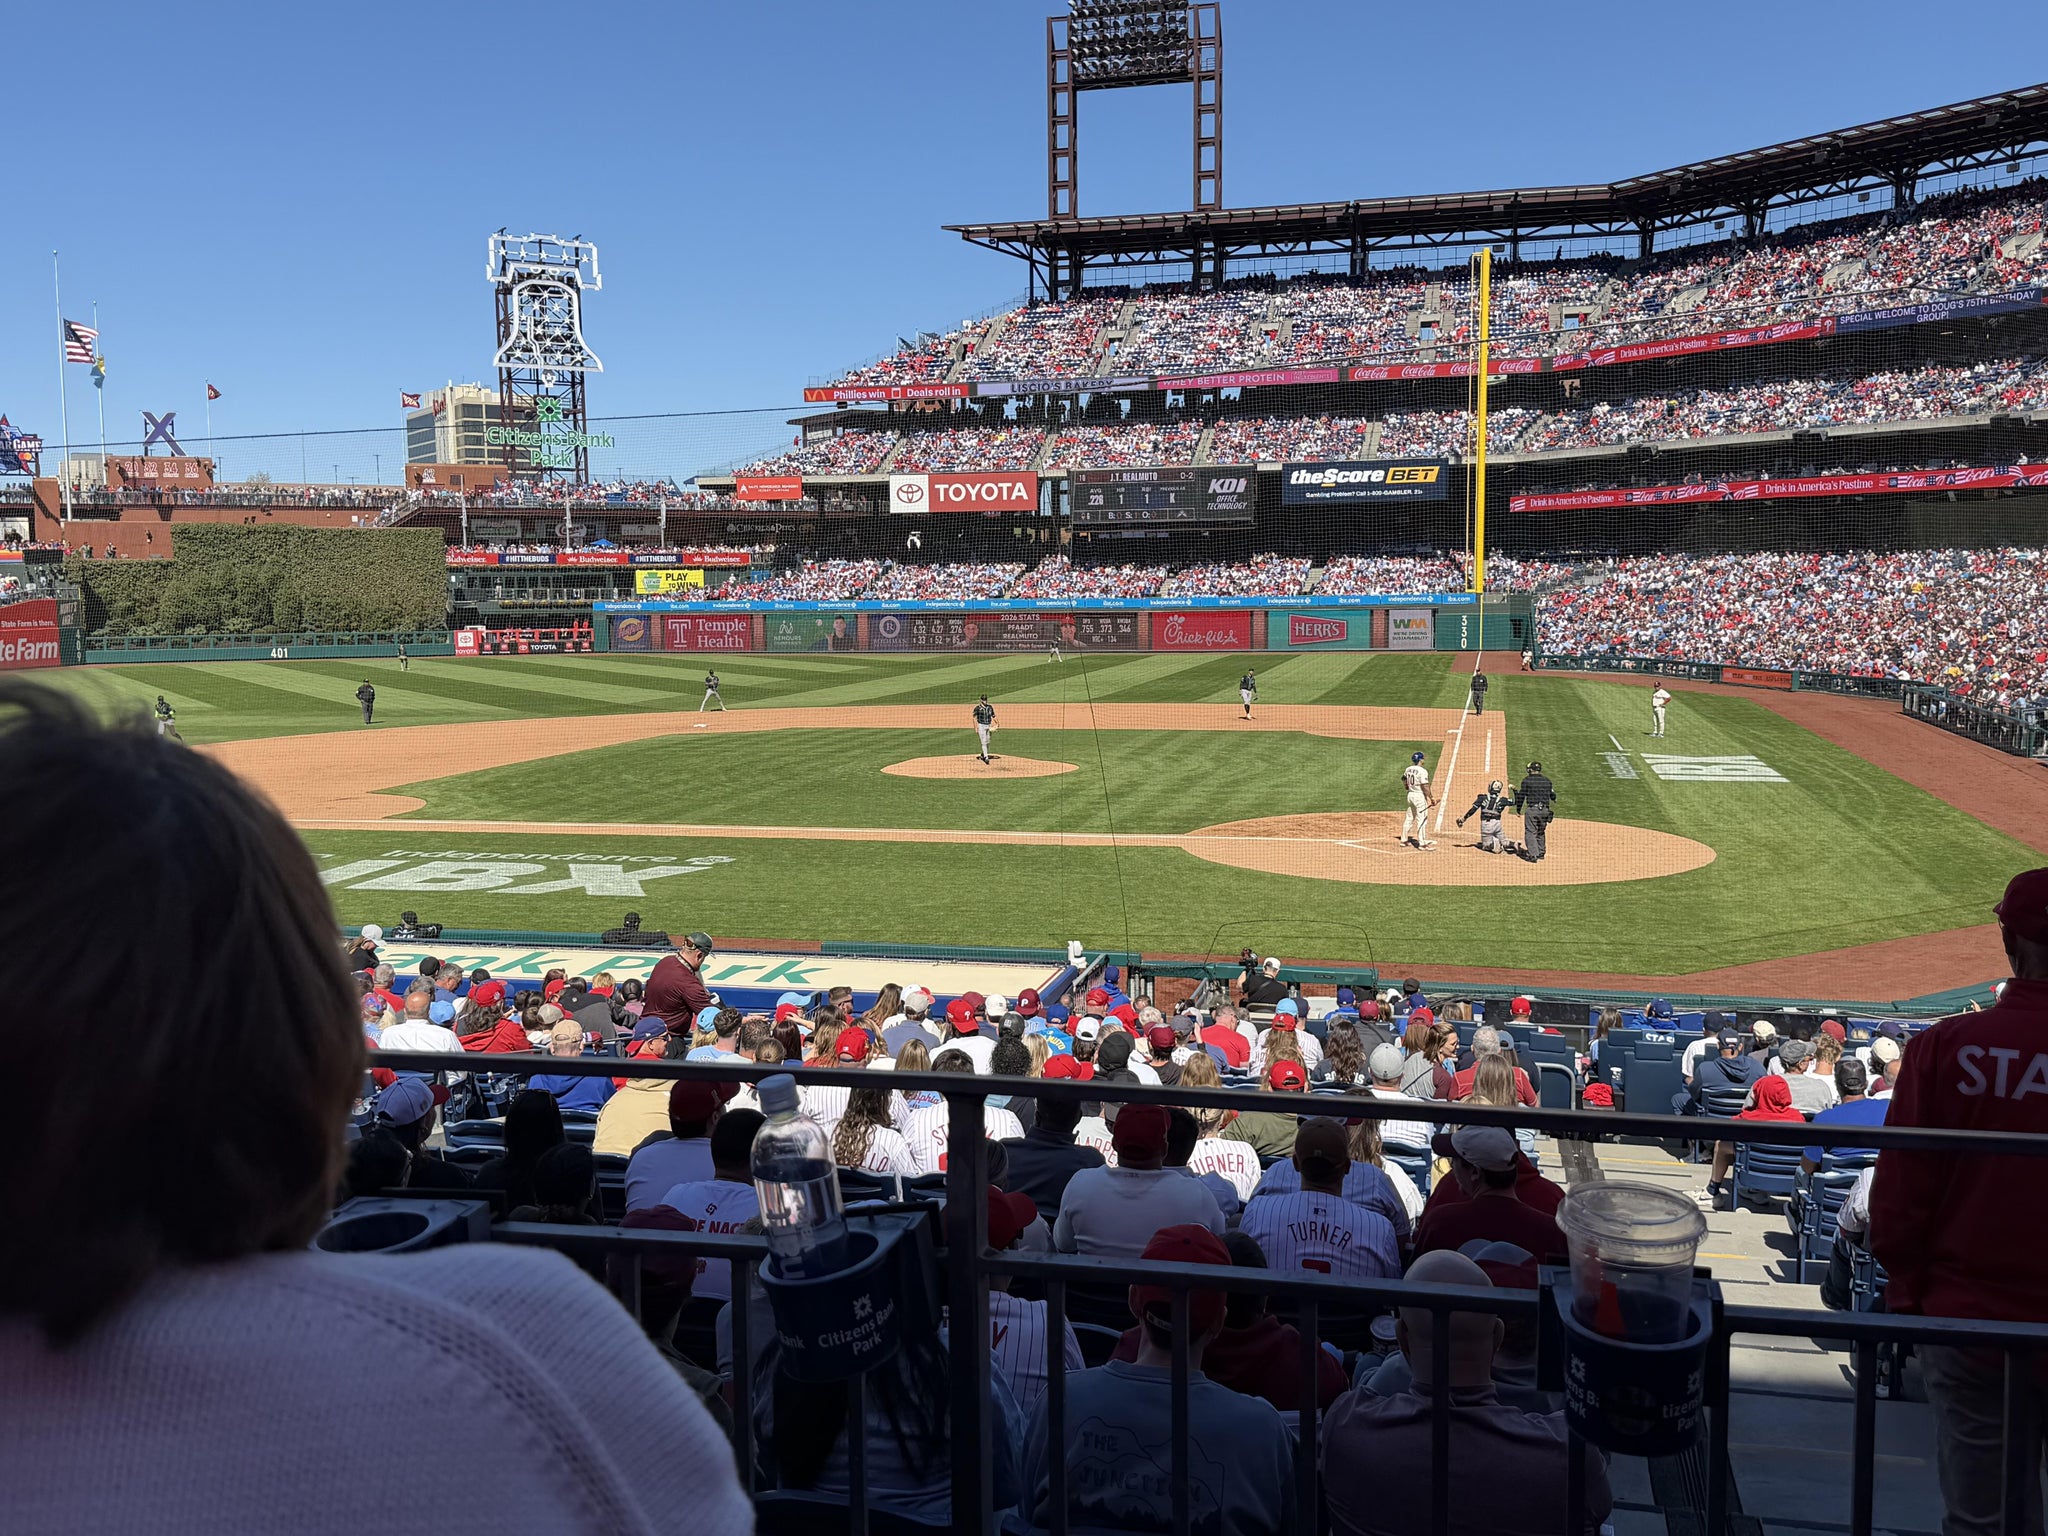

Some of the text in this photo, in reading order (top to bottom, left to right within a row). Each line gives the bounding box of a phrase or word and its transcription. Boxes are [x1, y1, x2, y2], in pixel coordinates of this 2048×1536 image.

[1840, 290, 2036, 324] SPECIAL WELCOME TO DOUG'S 75TH BIRTHDAY
[1917, 312, 1949, 323] GROUP!
[1620, 349, 1638, 358] Drink
[1646, 344, 1679, 354] America's
[1680, 339, 1707, 349] Pastime
[1354, 367, 1390, 379] Coca-Cola
[1402, 365, 1437, 377] Coca-Cola
[1498, 360, 1536, 372] Coca-Cola
[1163, 378, 1194, 386] WHEY
[1198, 376, 1235, 385] BETTER
[1239, 373, 1285, 382] PROTEIN
[834, 390, 866, 399] Phillies
[907, 387, 960, 397] Deals roll in
[1011, 382, 1060, 393] LISCIO'S
[486, 426, 613, 448] Citizens Bank
[13, 438, 42, 452] GAME
[530, 450, 572, 466] Park
[144, 462, 158, 472] 32
[185, 462, 198, 473] 36
[1122, 472, 1158, 481] REALMUTO
[1290, 468, 1434, 484] theScore BET
[934, 482, 1028, 502] TOYOTA
[1208, 478, 1248, 493] KDI
[1765, 478, 1873, 494] Drink in America's Pastime
[1170, 492, 1175, 504] K
[1530, 498, 1547, 507] Drink
[1555, 495, 1587, 505] America's
[1588, 494, 1614, 503] Pastime
[1207, 502, 1247, 510] TECHNOLOGY
[666, 573, 688, 581] PLAY
[696, 619, 746, 635] Temple
[1294, 621, 1340, 637] HERR'S
[1393, 619, 1427, 628] WM
[1164, 618, 1238, 646] Chick-fil-A
[697, 635, 744, 648] Health
[270, 648, 288, 658] 401
[382, 850, 678, 863] Independence
[373, 948, 832, 984] ank Prk
[1957, 1045, 2048, 1100] STA
[1078, 1136, 1118, 1166] ARPE
[1186, 1153, 1244, 1174] URNER
[709, 1220, 745, 1234] NAC
[1288, 1220, 1352, 1250] TURNER
[818, 1319, 876, 1348] Citizens
[852, 1331, 882, 1356] Park
[1082, 1431, 1119, 1452] THE
[1079, 1465, 1201, 1502] JUNCTIN
